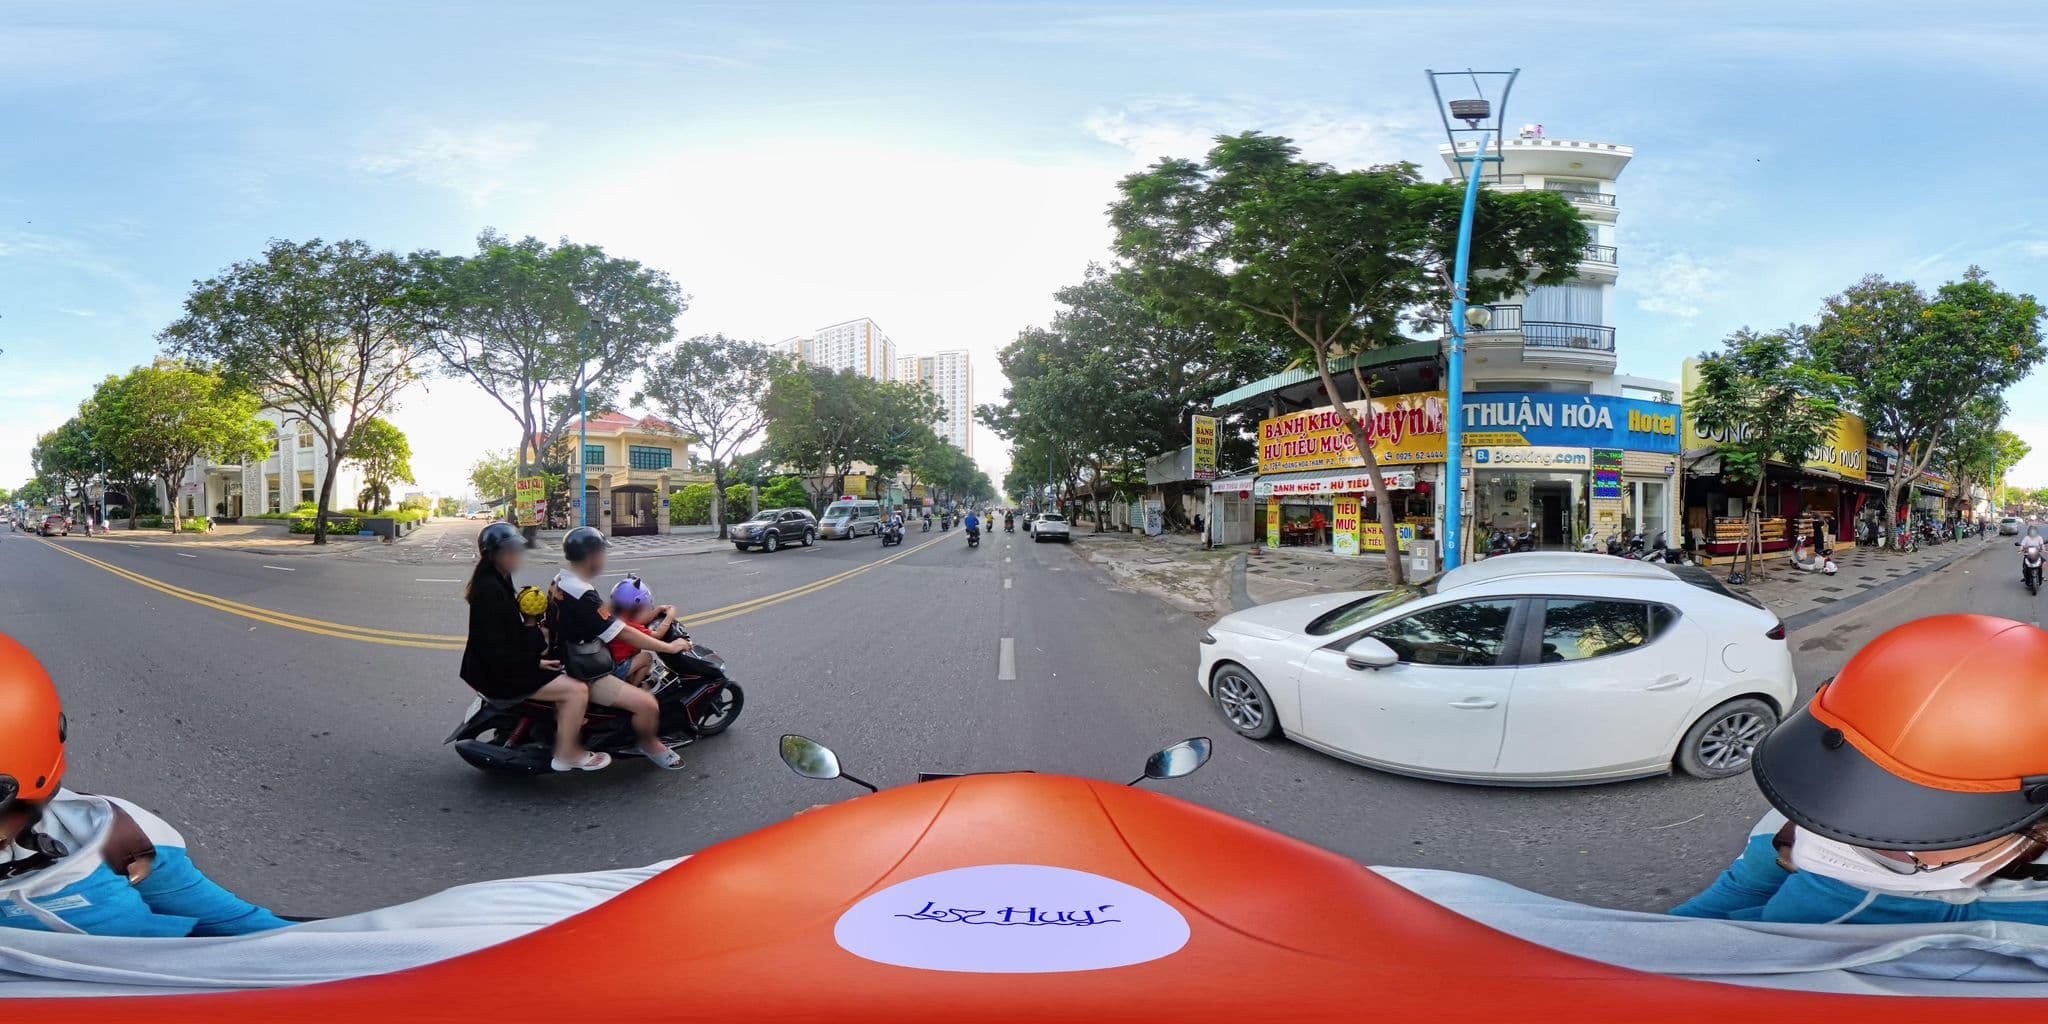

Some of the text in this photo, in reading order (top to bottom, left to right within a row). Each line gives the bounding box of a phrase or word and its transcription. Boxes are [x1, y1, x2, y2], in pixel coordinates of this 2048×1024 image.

[1308, 411, 1344, 431] KHỌ
[1462, 395, 1677, 437] THUẬN HÒA Hotel
[1284, 432, 1317, 457] TIẾU
[1494, 450, 1586, 466] Booking.com
